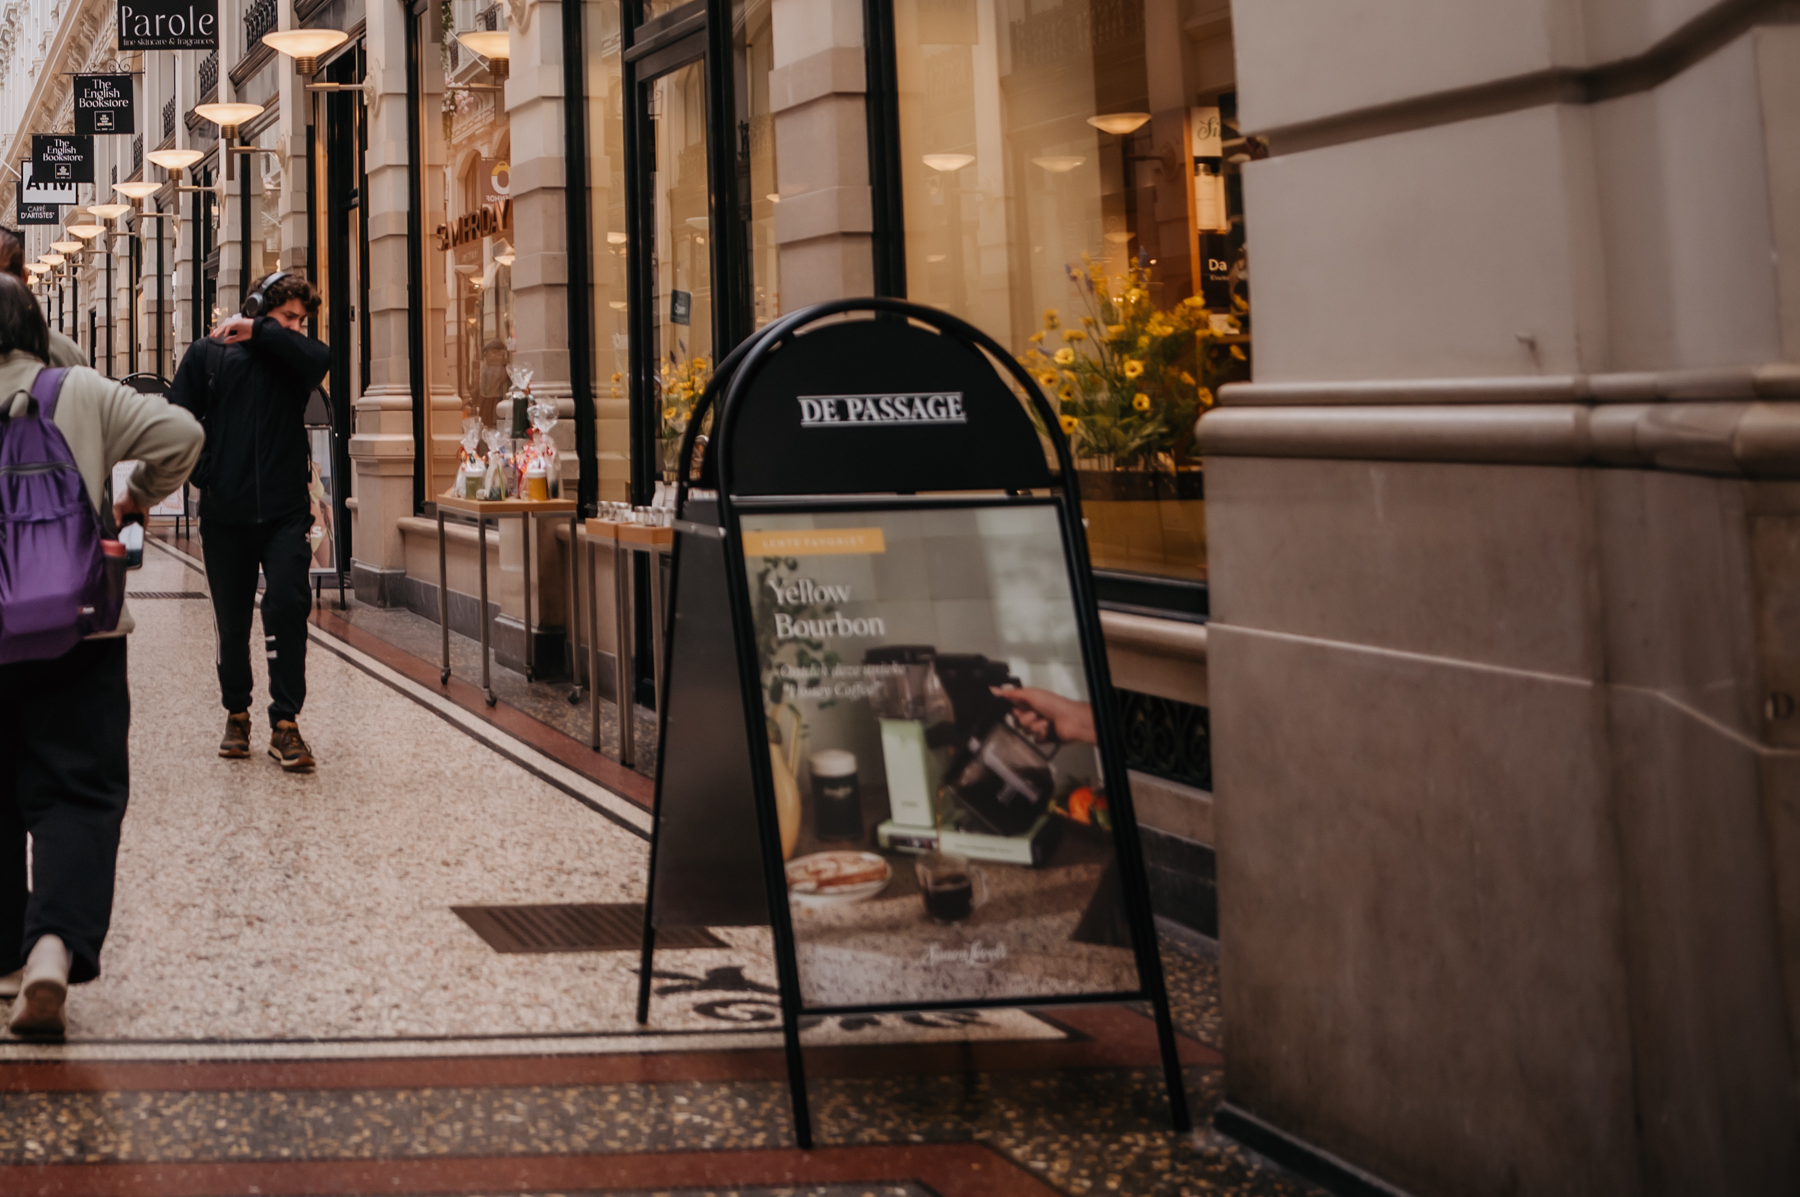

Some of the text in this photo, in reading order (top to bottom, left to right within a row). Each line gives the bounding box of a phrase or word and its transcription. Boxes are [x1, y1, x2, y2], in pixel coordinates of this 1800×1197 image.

[121, 5, 215, 37] Parole
[123, 38, 136, 46] fine
[138, 38, 167, 46] skincare
[177, 38, 215, 47] fragrances
[92, 79, 112, 89] The
[84, 88, 120, 100] English
[79, 98, 129, 108] Bookstore
[54, 139, 70, 147] The
[47, 146, 76, 155] English
[42, 153, 84, 161] Bookstore
[798, 393, 967, 424] DE PASSAGE
[762, 535, 866, 549] LENTE FAVORIET
[768, 578, 850, 605] Yellow
[774, 611, 886, 639] Bourbon
